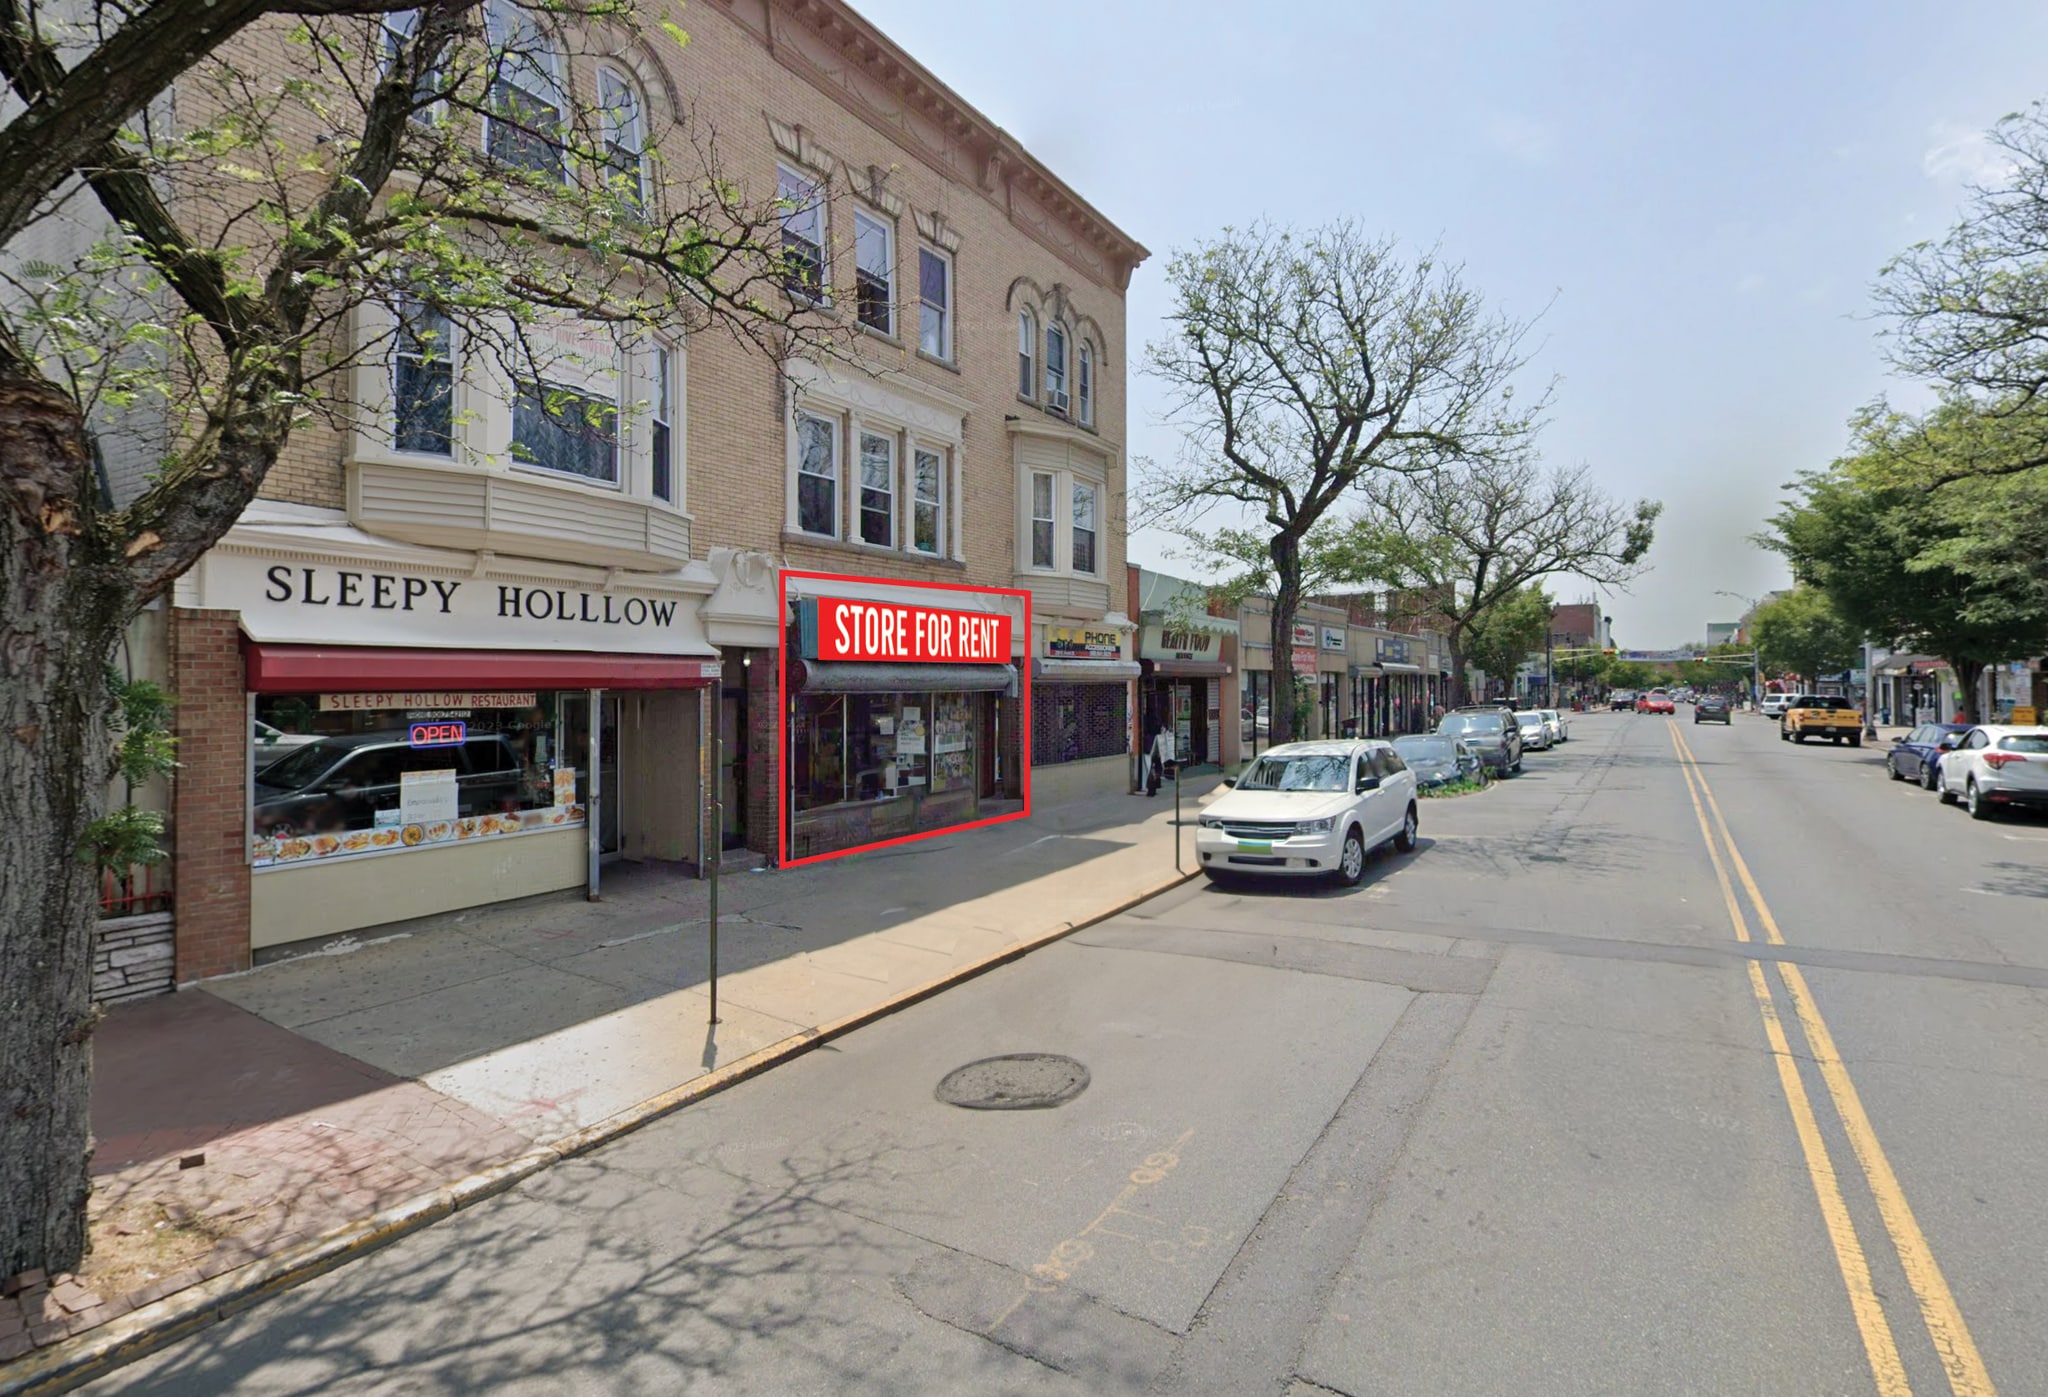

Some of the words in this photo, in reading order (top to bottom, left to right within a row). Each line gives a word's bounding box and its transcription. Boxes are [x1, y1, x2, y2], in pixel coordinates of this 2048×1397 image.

[265, 565, 462, 614] SLEEPY
[497, 585, 678, 628] HOLLLOW
[1084, 631, 1116, 645] PHONE
[330, 695, 393, 709] SLEEPY
[404, 694, 463, 707] HOLLOW
[471, 694, 537, 707] RESTAURANT
[412, 725, 463, 745] OPEN
